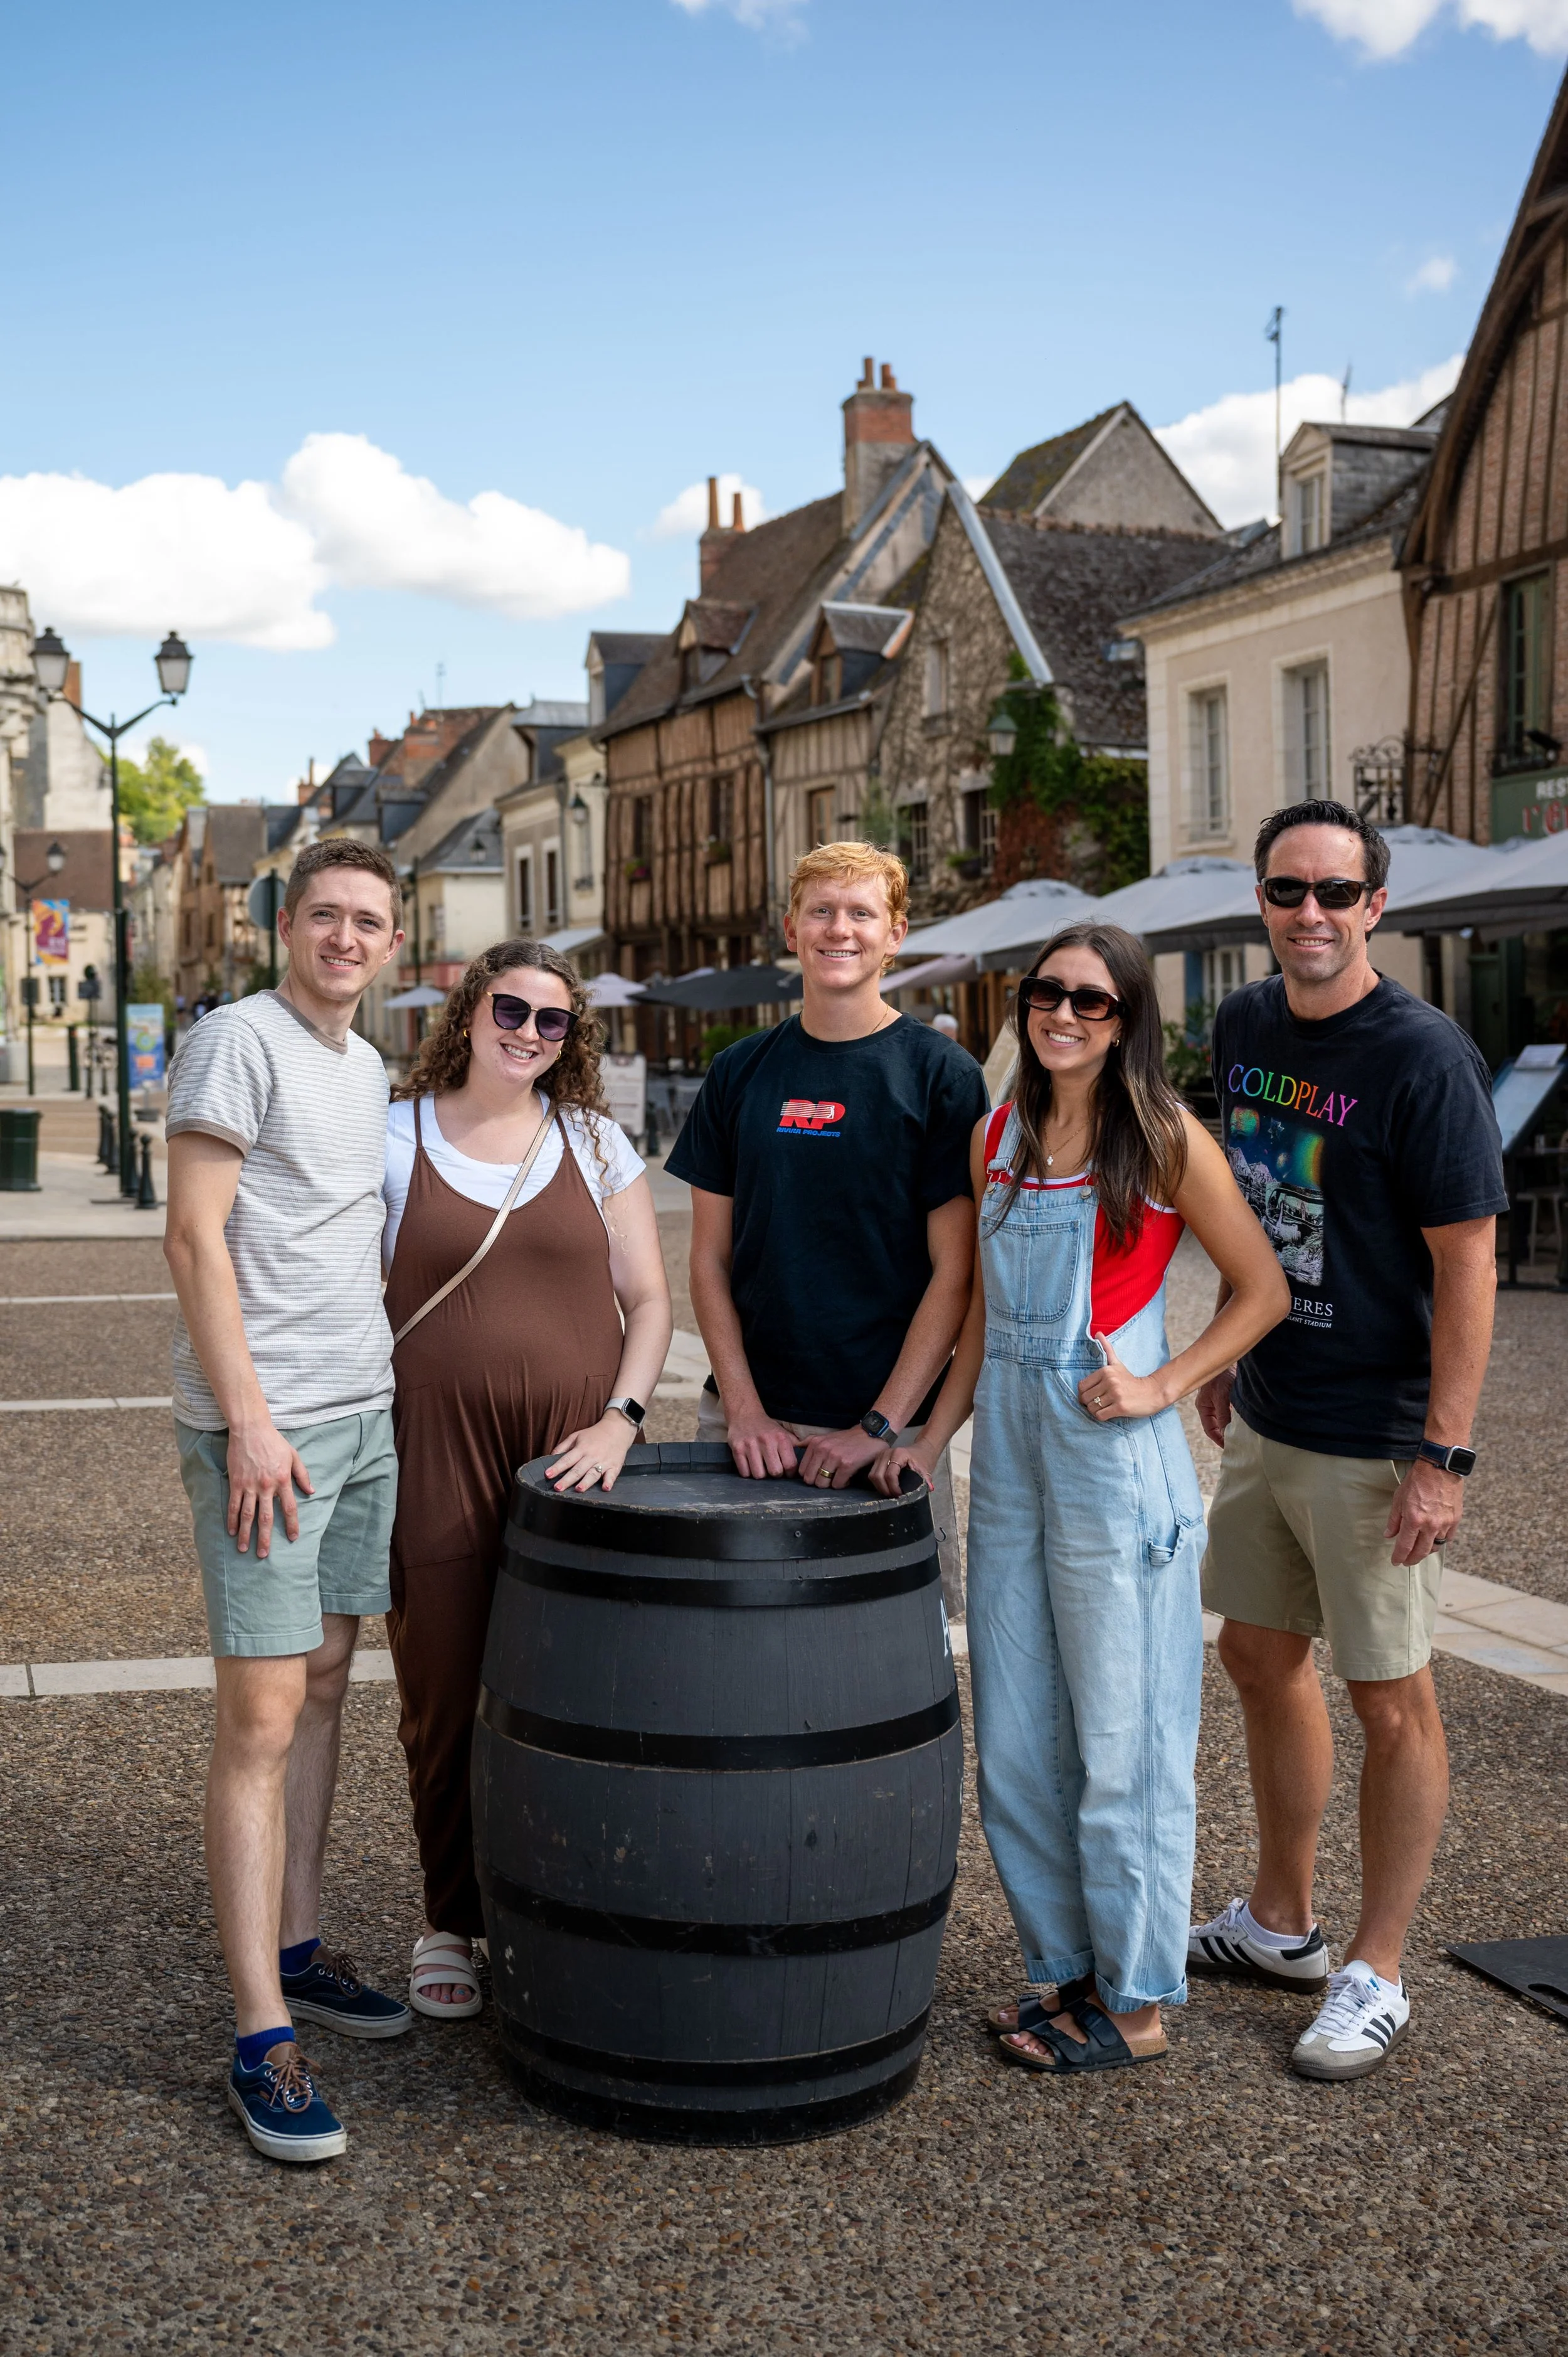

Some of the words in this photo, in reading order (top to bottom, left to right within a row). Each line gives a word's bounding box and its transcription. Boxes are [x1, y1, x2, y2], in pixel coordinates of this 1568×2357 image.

[1228, 1064, 1358, 1127] COLDPLAY
[1291, 1296, 1333, 1316] ERES
[1304, 1319, 1332, 1328] STADIUM
